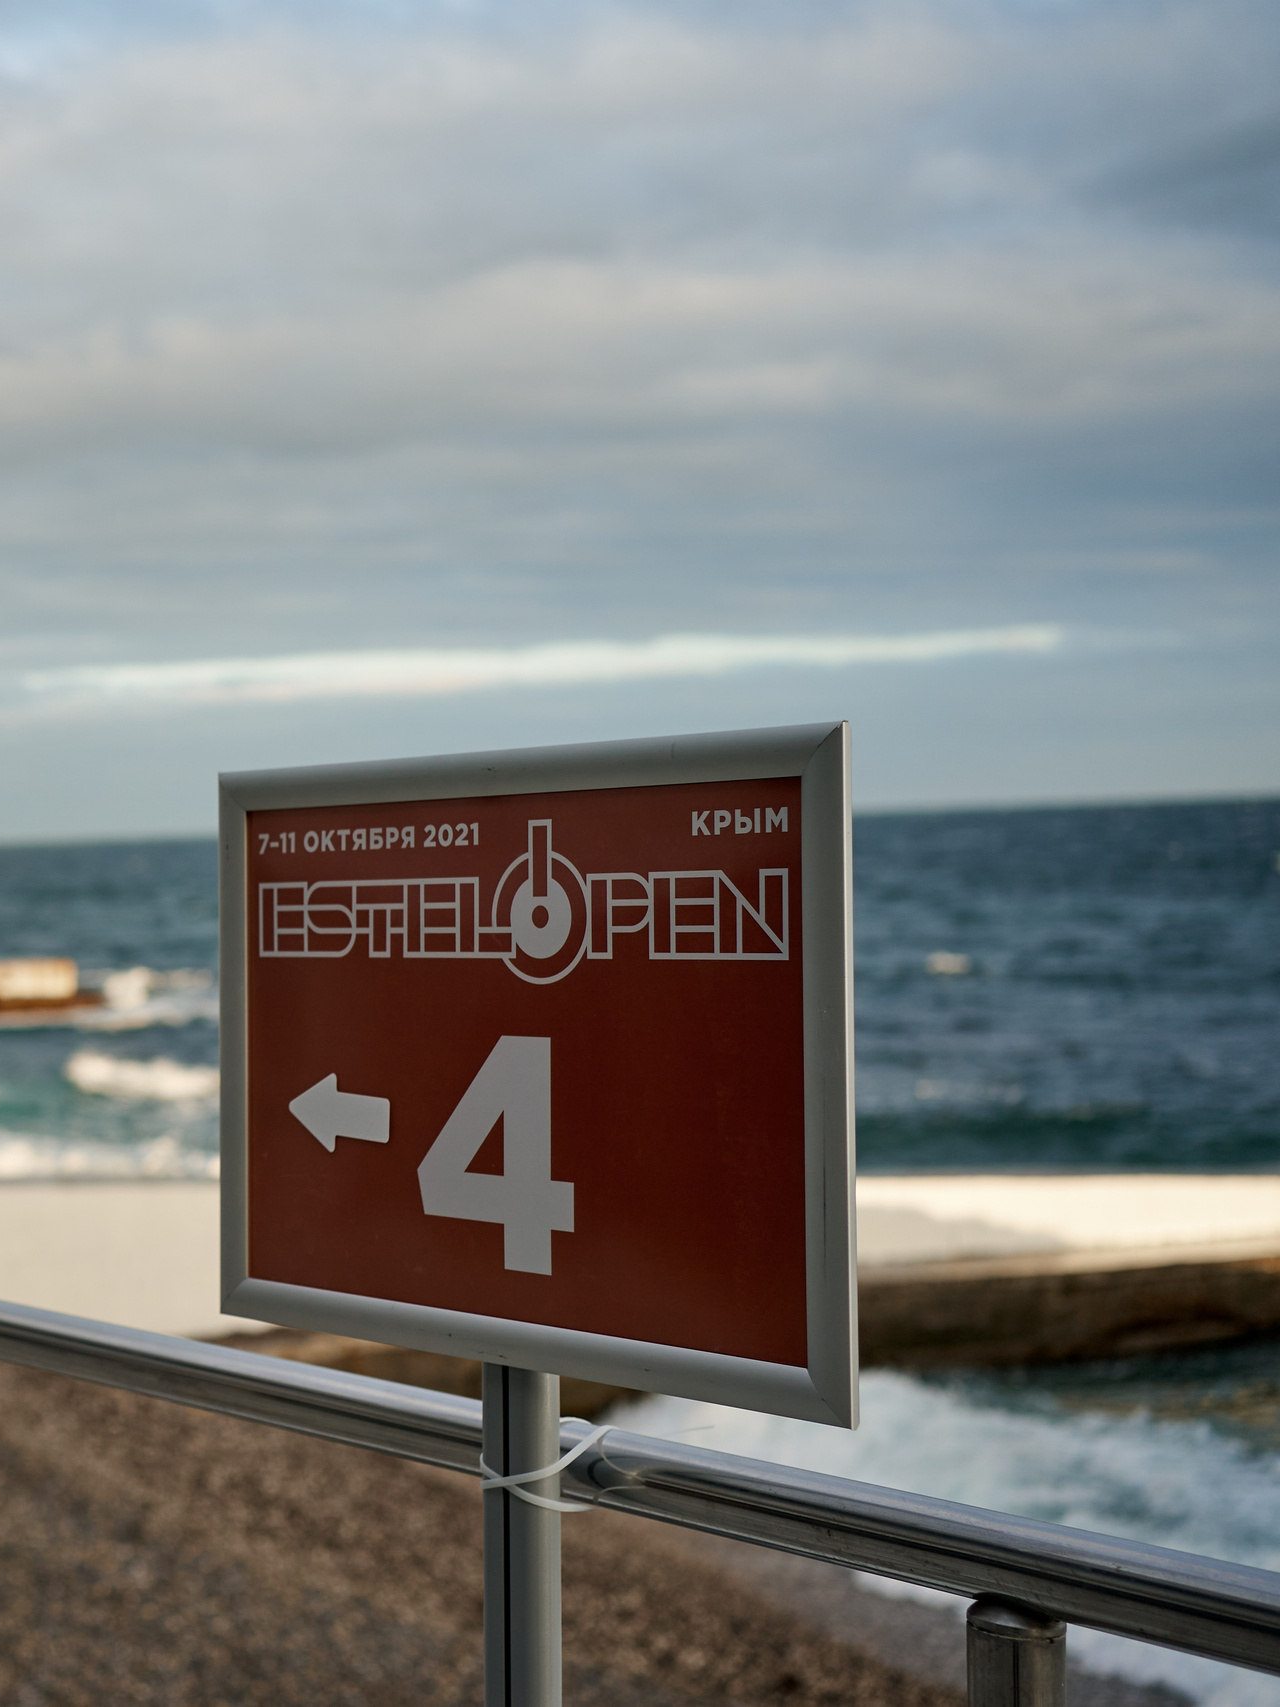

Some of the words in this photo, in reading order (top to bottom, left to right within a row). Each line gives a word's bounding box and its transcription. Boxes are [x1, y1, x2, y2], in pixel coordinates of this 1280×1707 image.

[691, 806, 788, 837] КРЫМ
[258, 831, 296, 855] 7-11
[303, 825, 415, 853] ОКТЯБРЯ
[423, 822, 479, 848] 2021
[417, 1035, 575, 1276] 4
